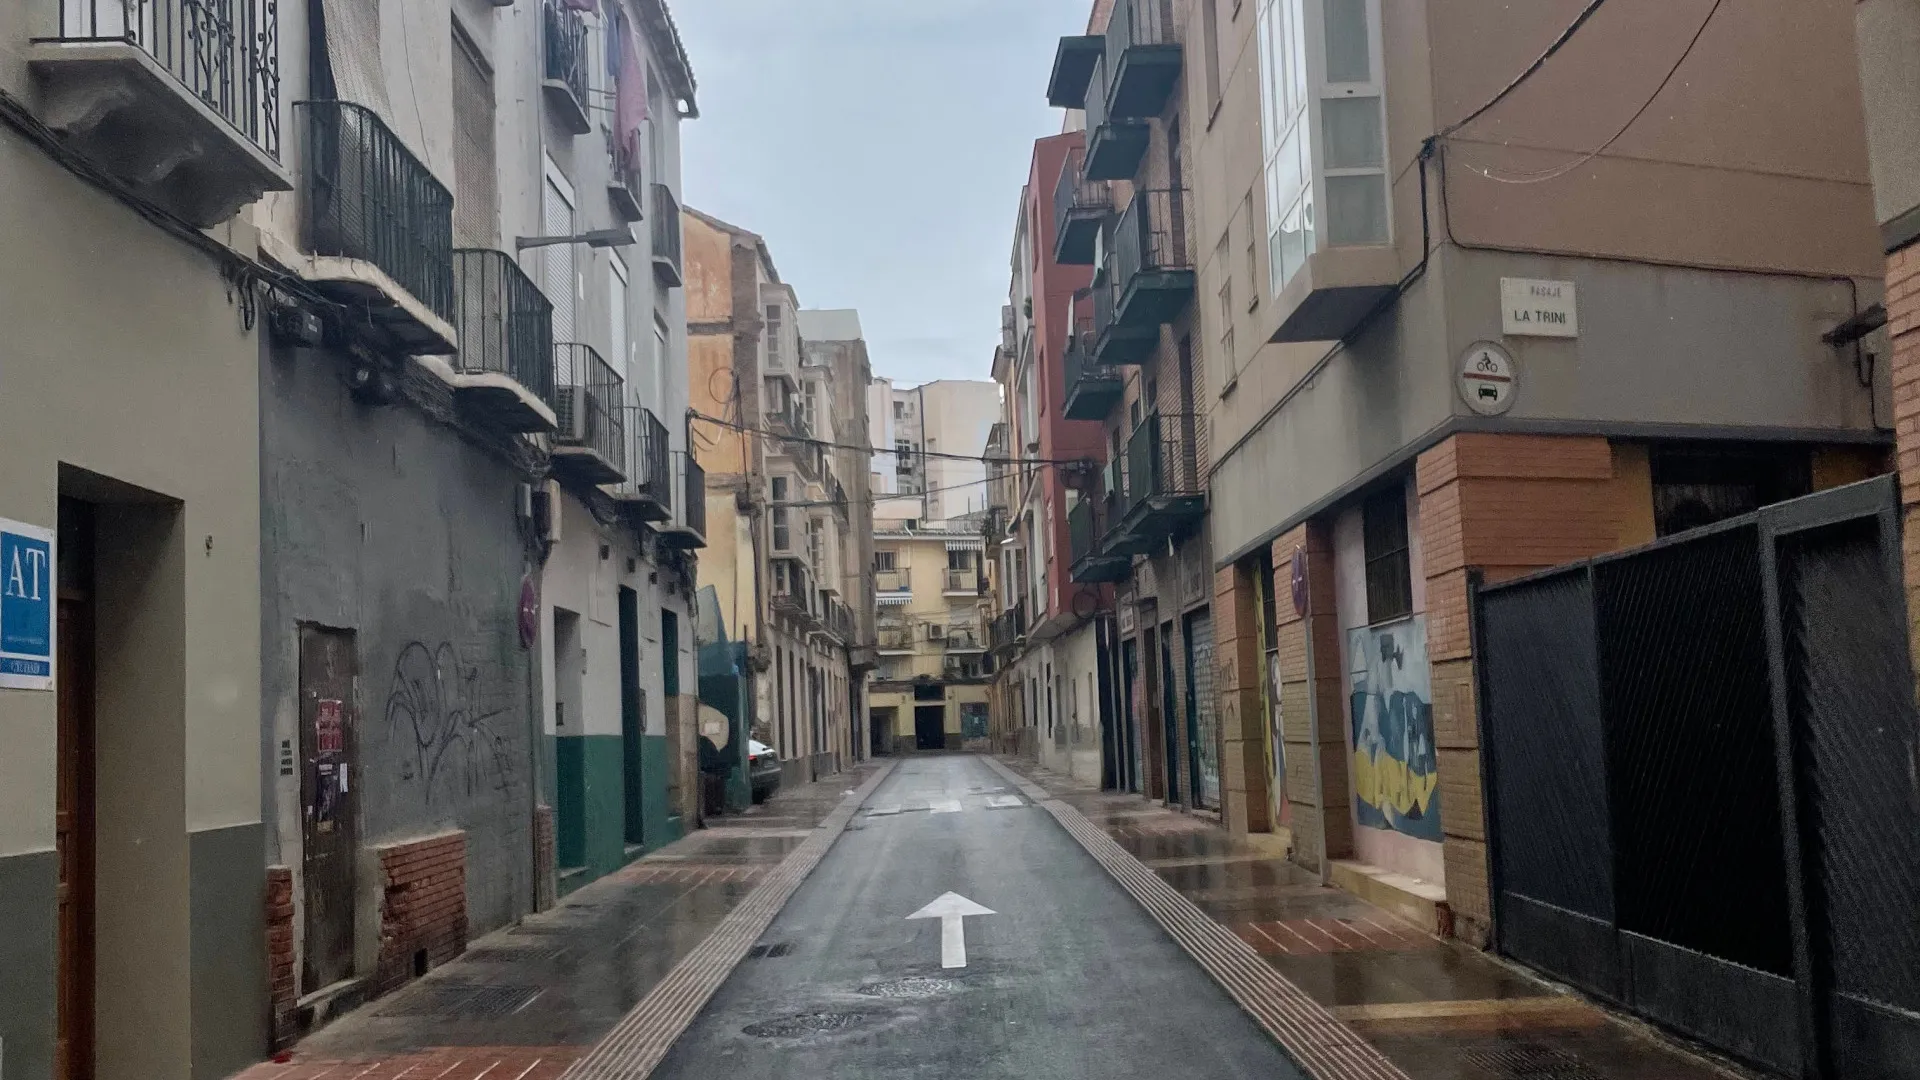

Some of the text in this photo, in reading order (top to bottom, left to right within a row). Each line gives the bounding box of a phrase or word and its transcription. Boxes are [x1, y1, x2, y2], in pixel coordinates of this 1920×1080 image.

[1530, 285, 1562, 297] PASAJE
[1514, 309, 1566, 324] LA TRINI
[5, 544, 46, 601] AT
